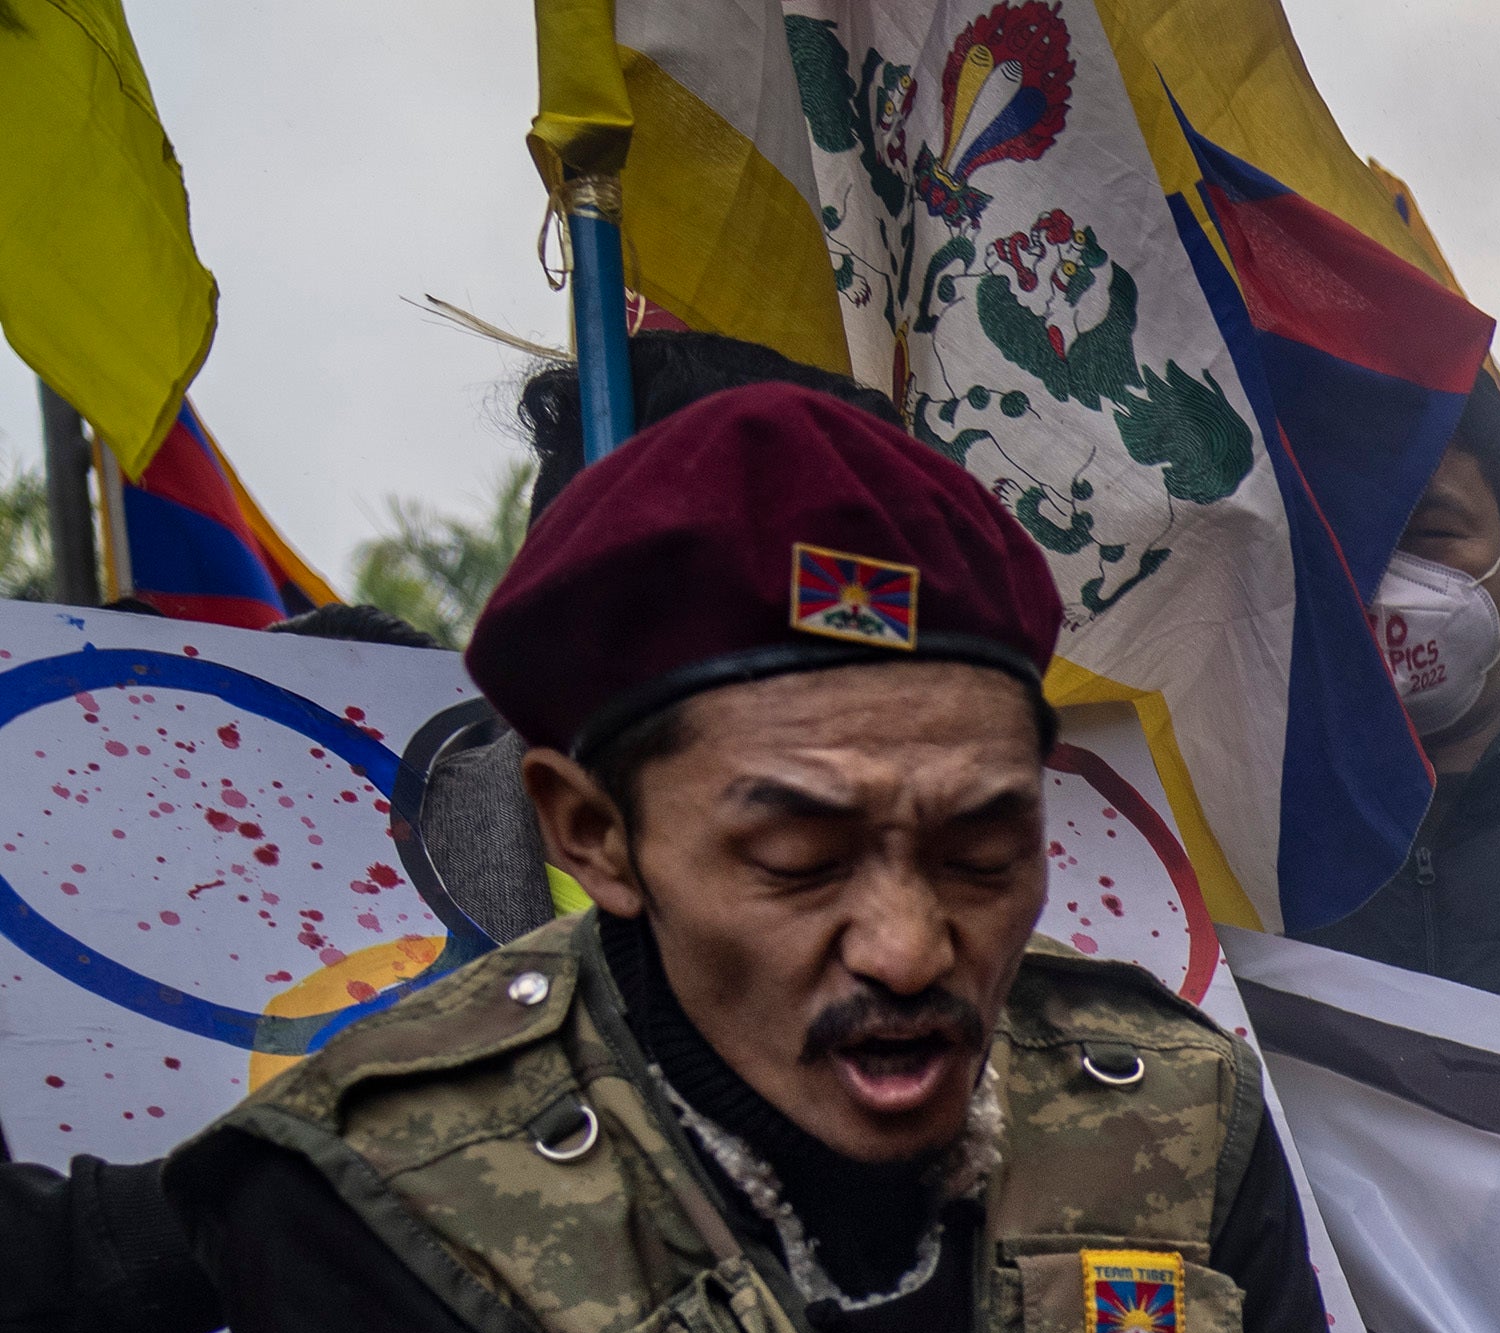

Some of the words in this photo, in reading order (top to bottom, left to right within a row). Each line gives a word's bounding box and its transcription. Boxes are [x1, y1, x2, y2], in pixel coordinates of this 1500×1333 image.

[1409, 664, 1448, 694] 2022
[1094, 1265, 1133, 1280] TEAM
[1136, 1267, 1175, 1283] TIBET
